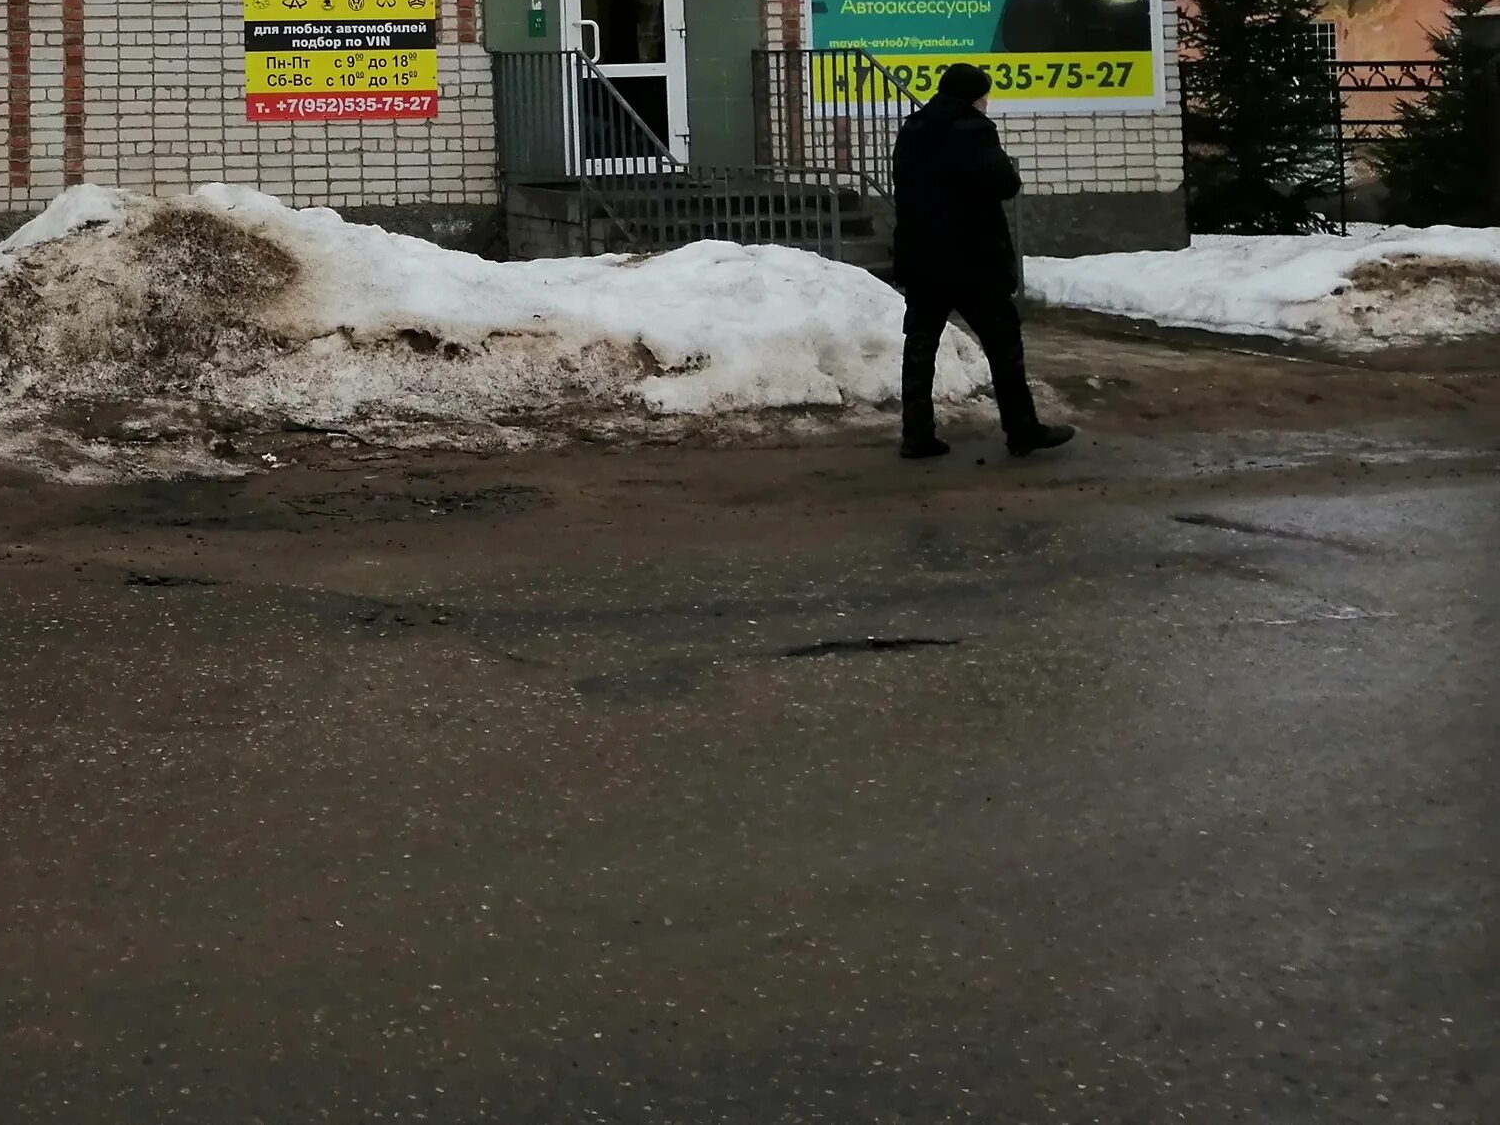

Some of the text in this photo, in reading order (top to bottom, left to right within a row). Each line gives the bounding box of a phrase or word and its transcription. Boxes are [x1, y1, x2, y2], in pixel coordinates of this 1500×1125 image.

[254, 22, 427, 36] для любых автомобилей
[292, 36, 391, 49] подбор по VIN
[266, 57, 310, 69] Пн-Пт
[334, 59, 342, 68] с
[368, 58, 387, 70] до
[267, 74, 313, 86] Сб-Вс
[326, 77, 334, 86] с
[368, 76, 388, 88] до
[255, 96, 432, 117] т. +7(952)535-75-27
